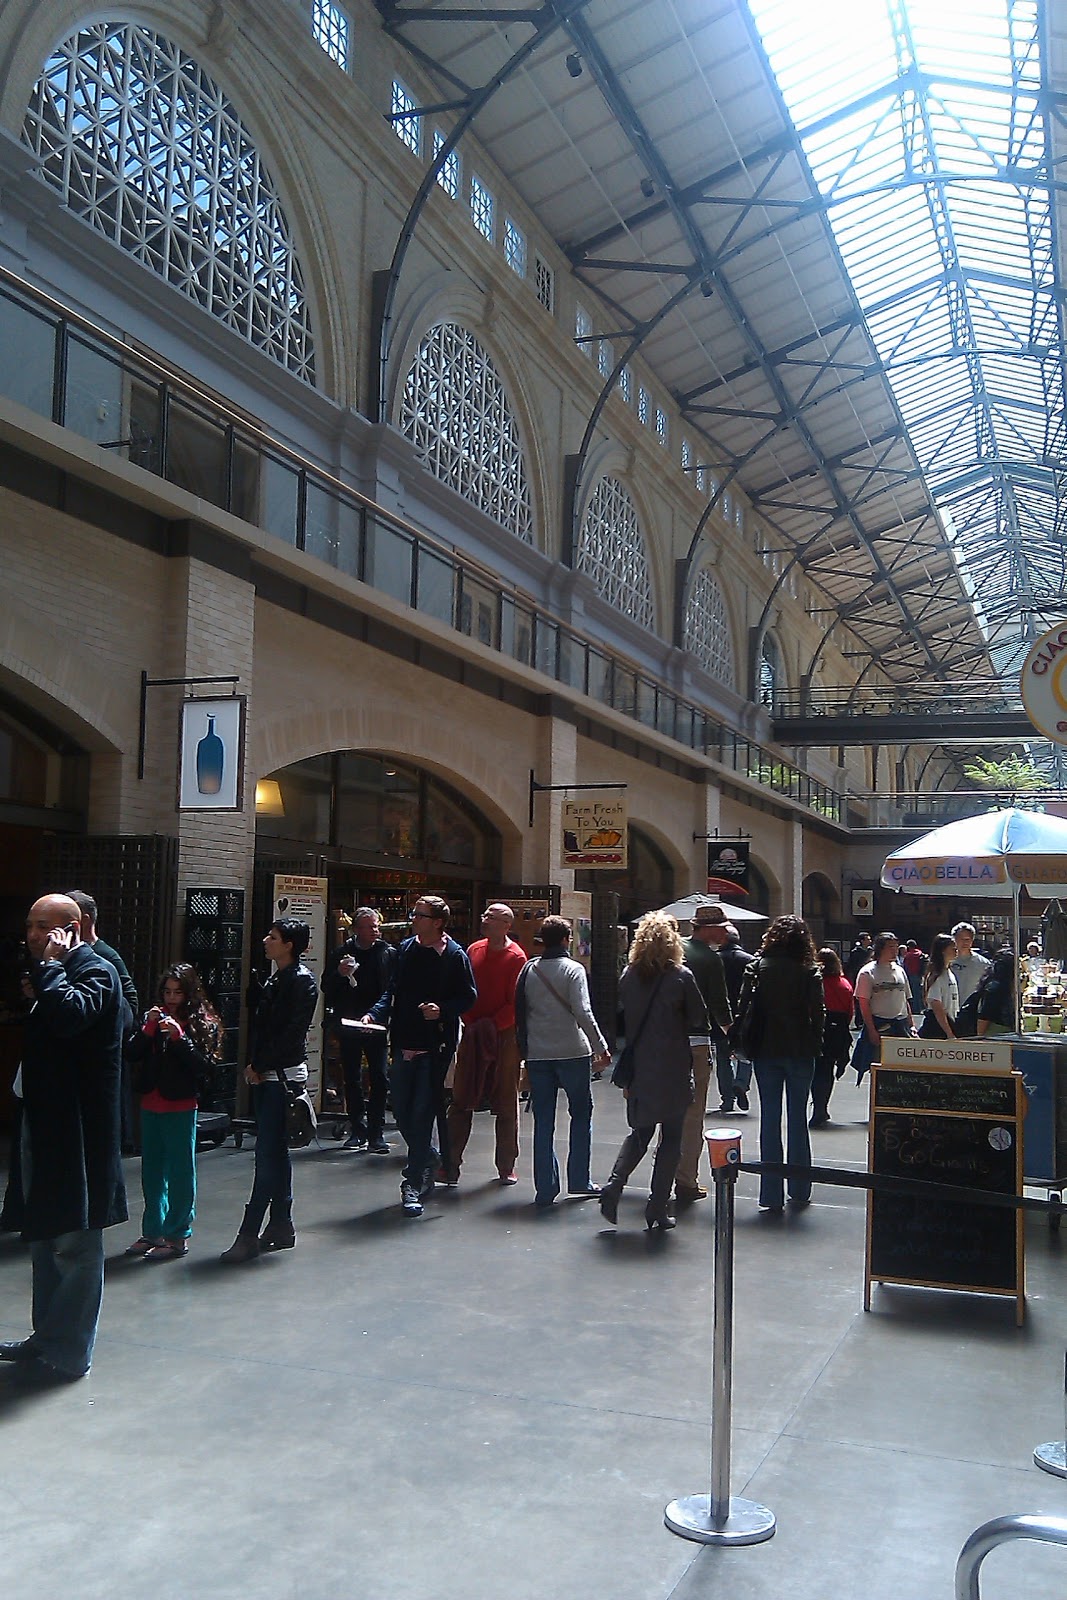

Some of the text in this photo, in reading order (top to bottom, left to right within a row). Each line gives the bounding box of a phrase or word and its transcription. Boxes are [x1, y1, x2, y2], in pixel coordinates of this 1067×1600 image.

[1031, 629, 1067, 675] CIAO
[565, 803, 623, 815] Farm Fresh
[574, 816, 614, 828] To You
[891, 865, 993, 881] CIAO BELLA
[896, 1047, 996, 1063] GELATO-SORBET
